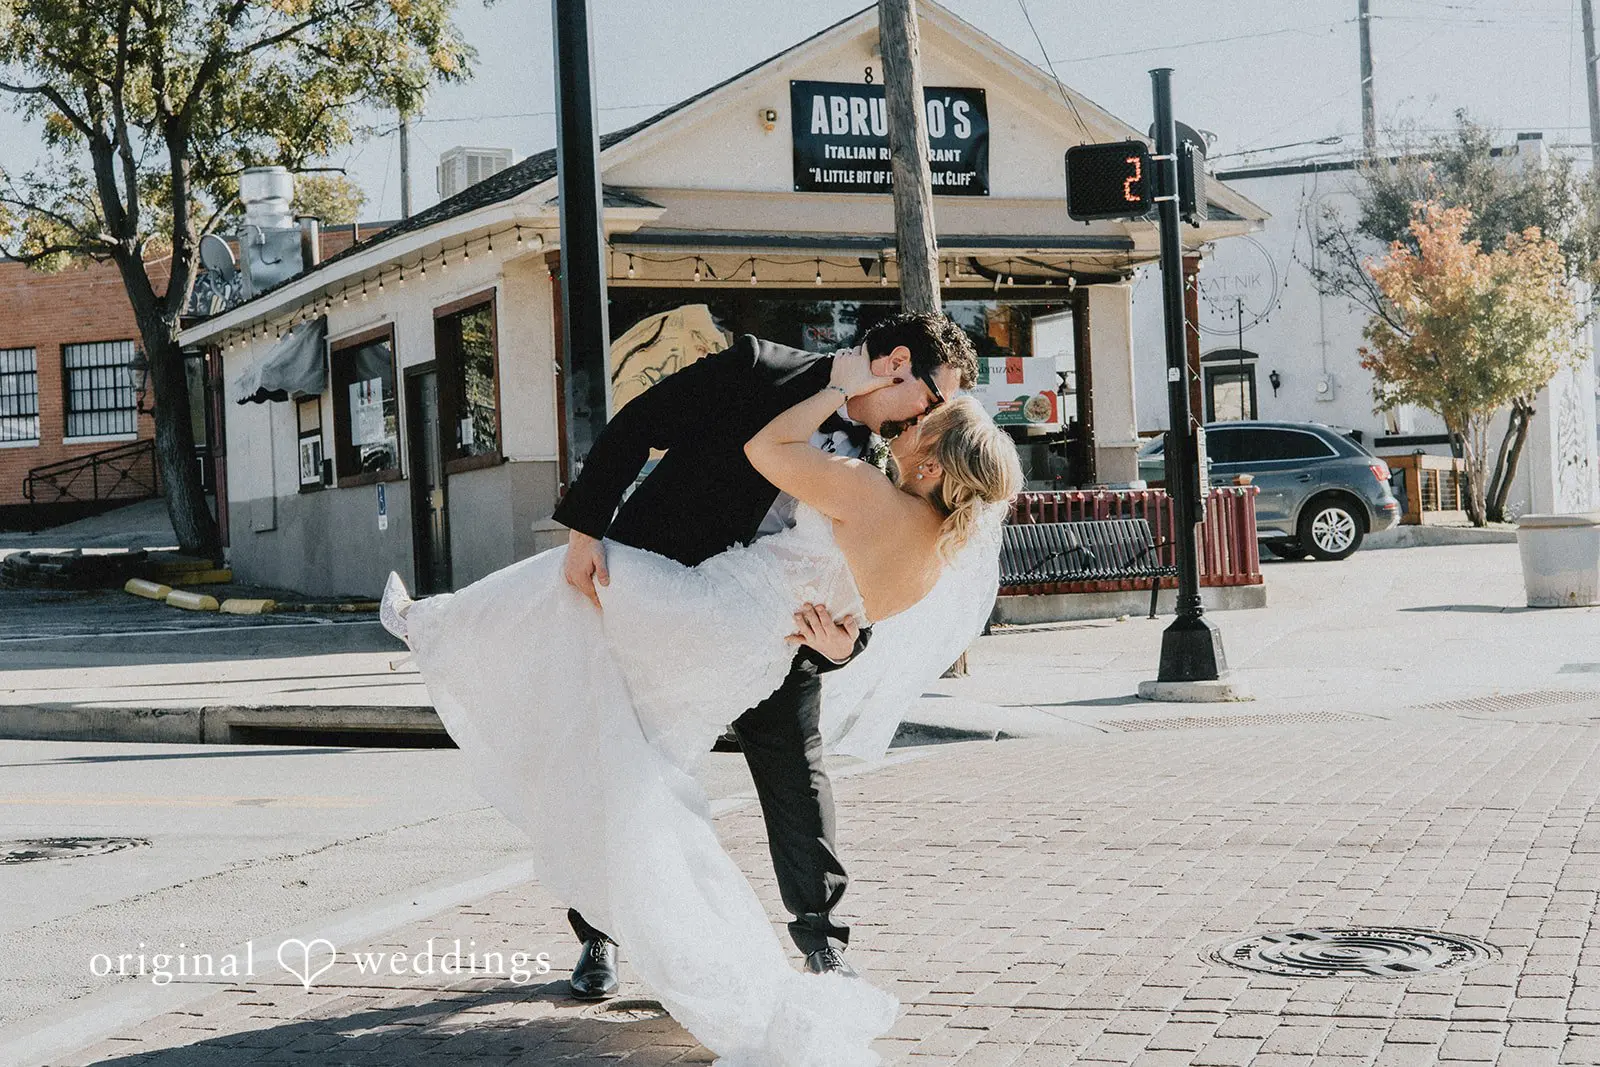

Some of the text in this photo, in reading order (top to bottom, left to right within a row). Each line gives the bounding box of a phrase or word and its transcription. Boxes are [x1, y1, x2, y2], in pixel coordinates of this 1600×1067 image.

[811, 95, 972, 139] ABRUO'S
[825, 144, 876, 160] ITALIAN
[824, 170, 855, 183] LITTLE
[857, 170, 872, 184] BIT
[874, 171, 885, 184] OF
[1123, 156, 1141, 201] 2
